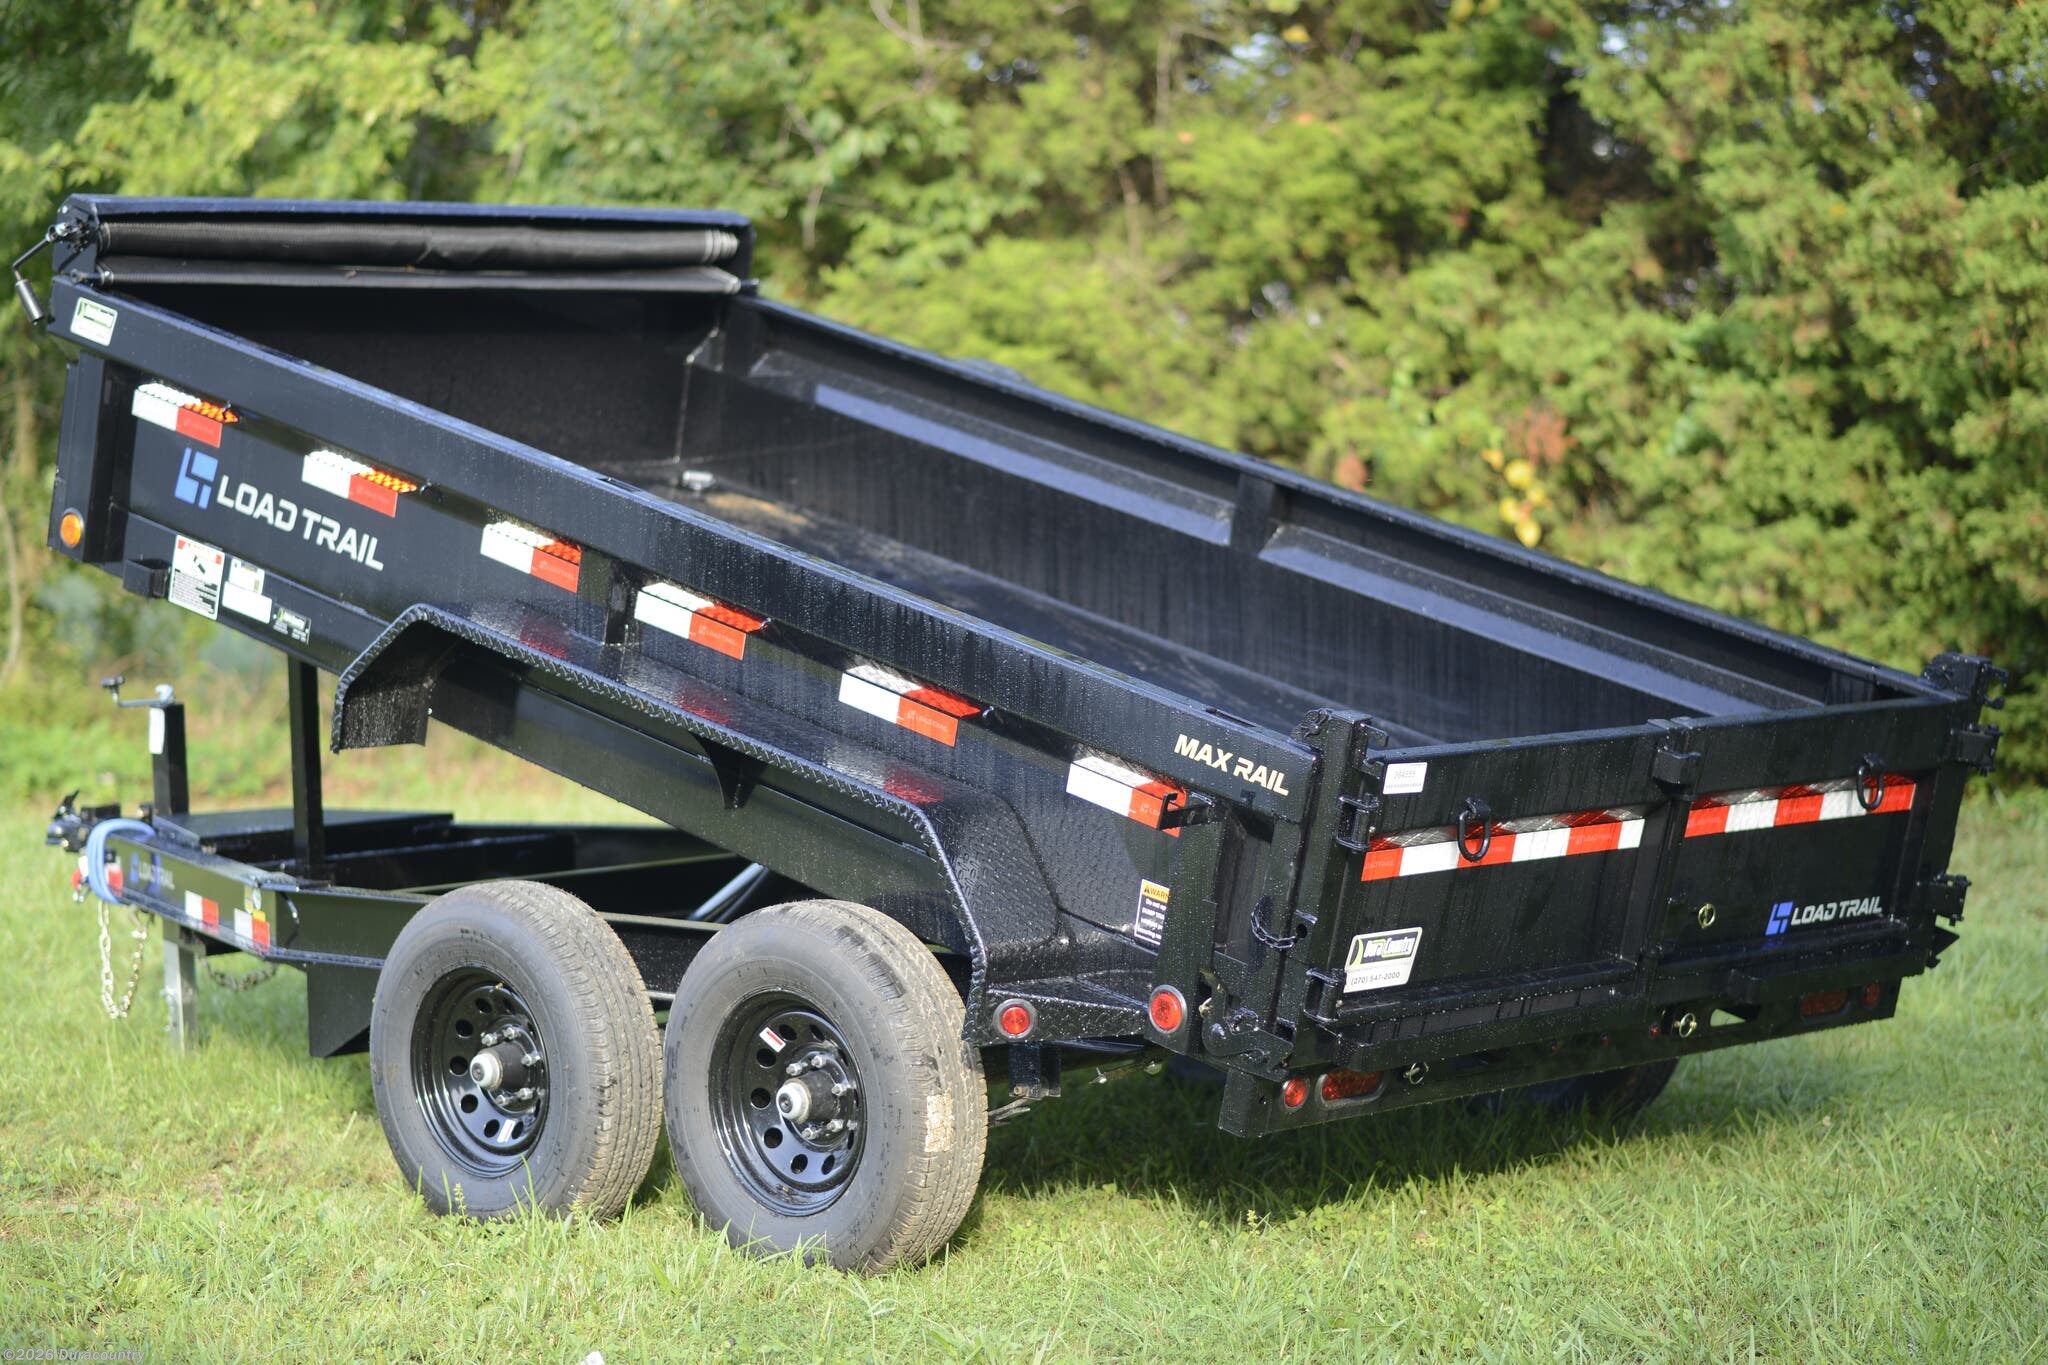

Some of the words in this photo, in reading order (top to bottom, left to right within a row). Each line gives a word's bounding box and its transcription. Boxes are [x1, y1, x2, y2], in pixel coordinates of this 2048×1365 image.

[217, 475, 298, 532] LOAD
[302, 508, 384, 571] TRAIL
[1174, 734, 1233, 772] MAX
[1233, 757, 1289, 796] RAIL
[1791, 902, 1838, 926] LOAD
[1839, 896, 1882, 918] TRAIL
[1350, 975, 1368, 986] (270)
